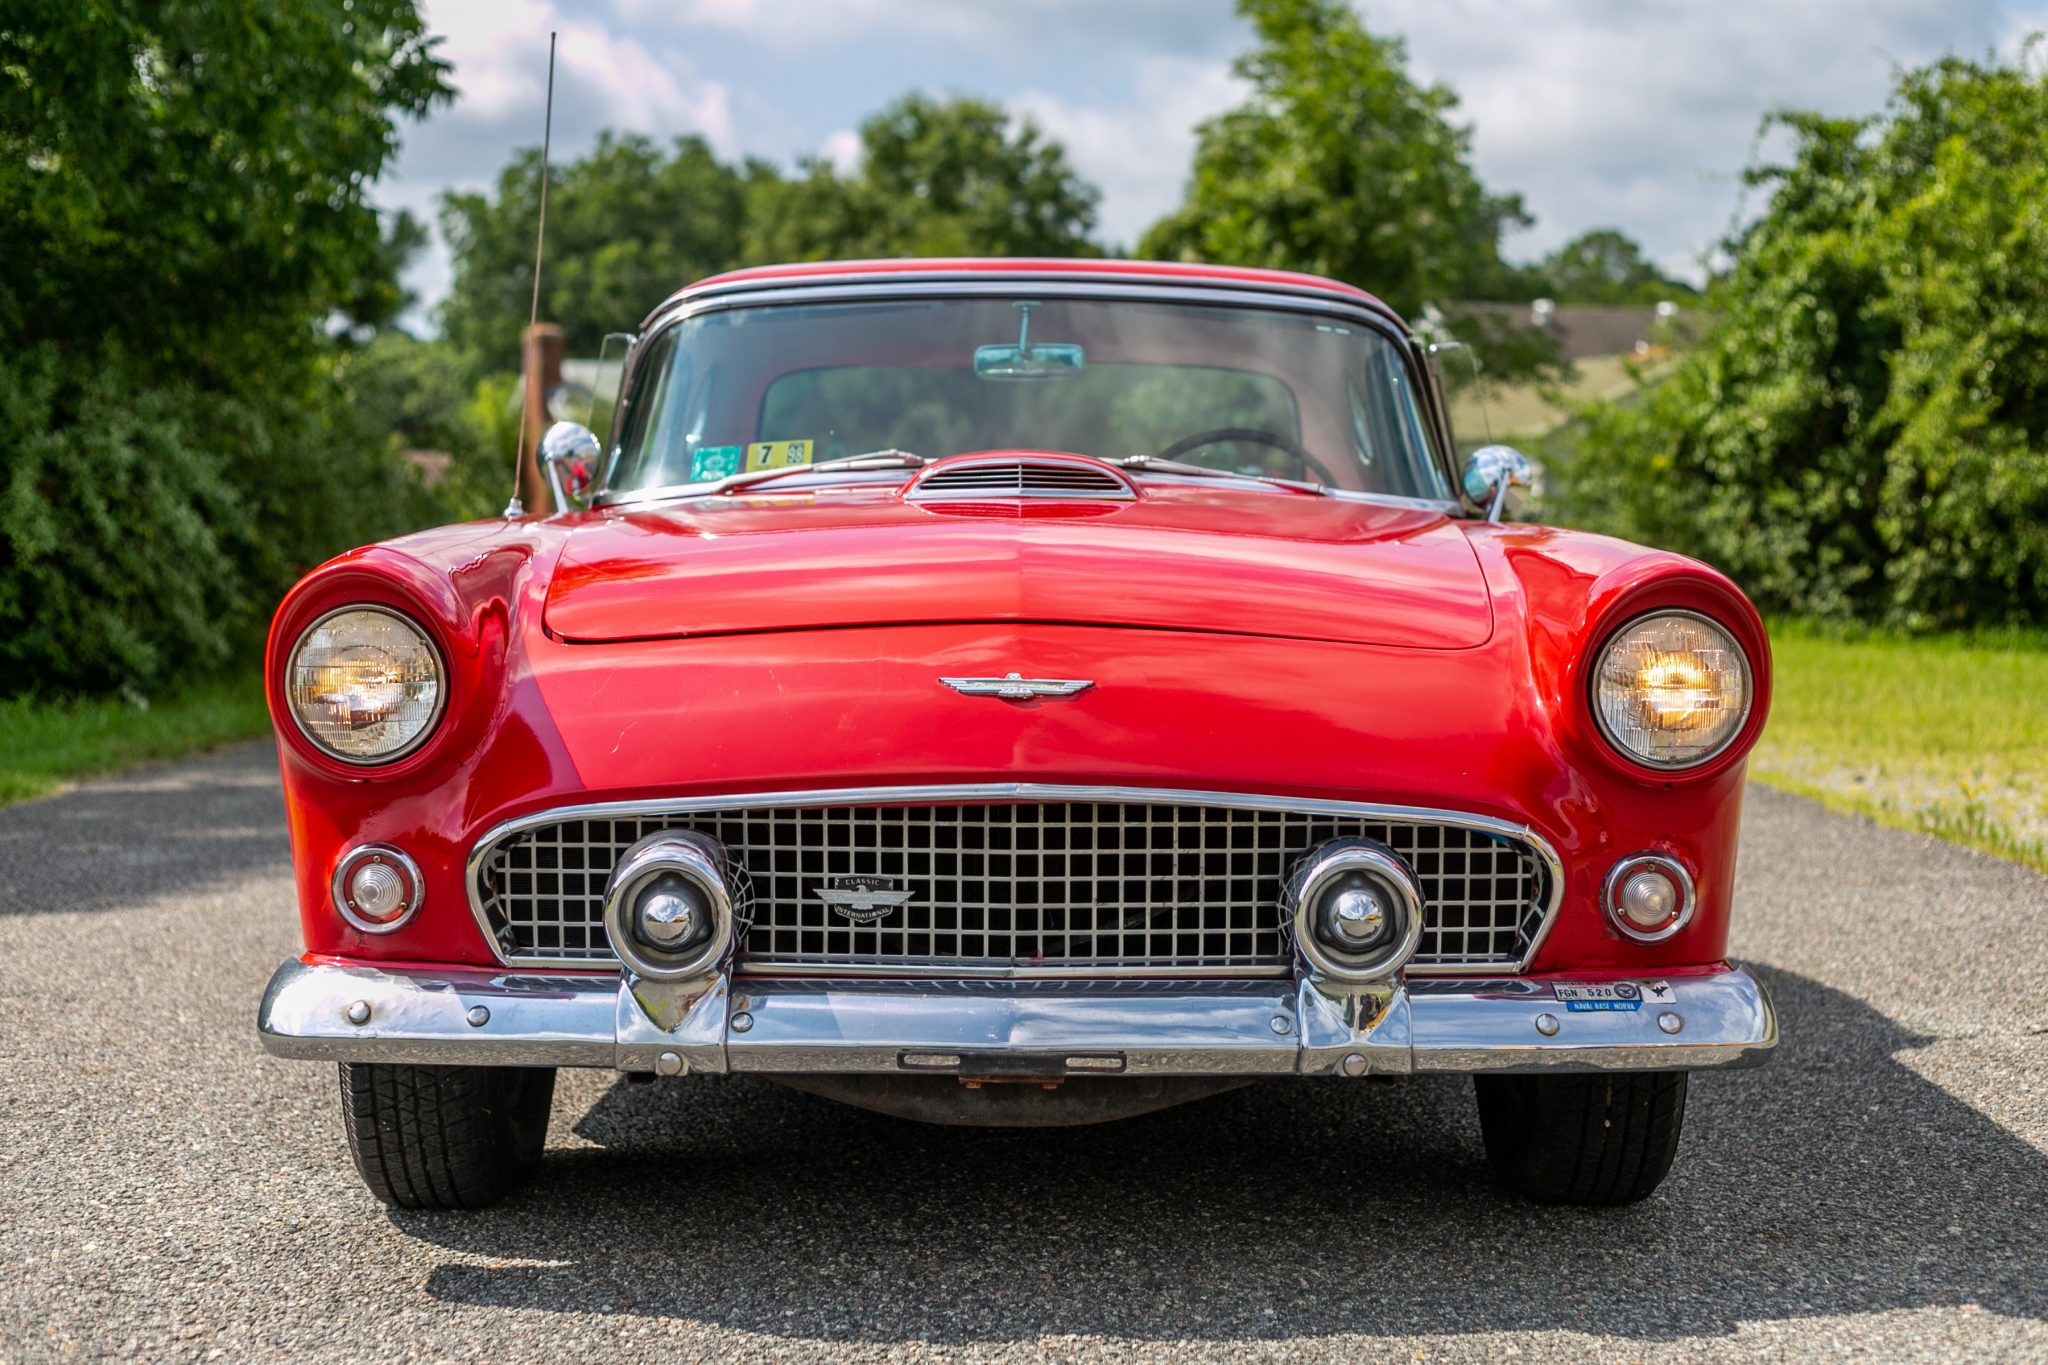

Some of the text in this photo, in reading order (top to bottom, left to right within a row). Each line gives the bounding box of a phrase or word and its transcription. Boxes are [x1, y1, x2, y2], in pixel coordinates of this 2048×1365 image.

[761, 445, 772, 463] 7
[845, 878, 880, 886] CLASSIC
[836, 905, 890, 918] INTERNATIONAL
[1557, 988, 1611, 997] FGN 520
[1574, 1002, 1593, 1010] NAVAL
[1594, 1002, 1610, 1010] BASE
